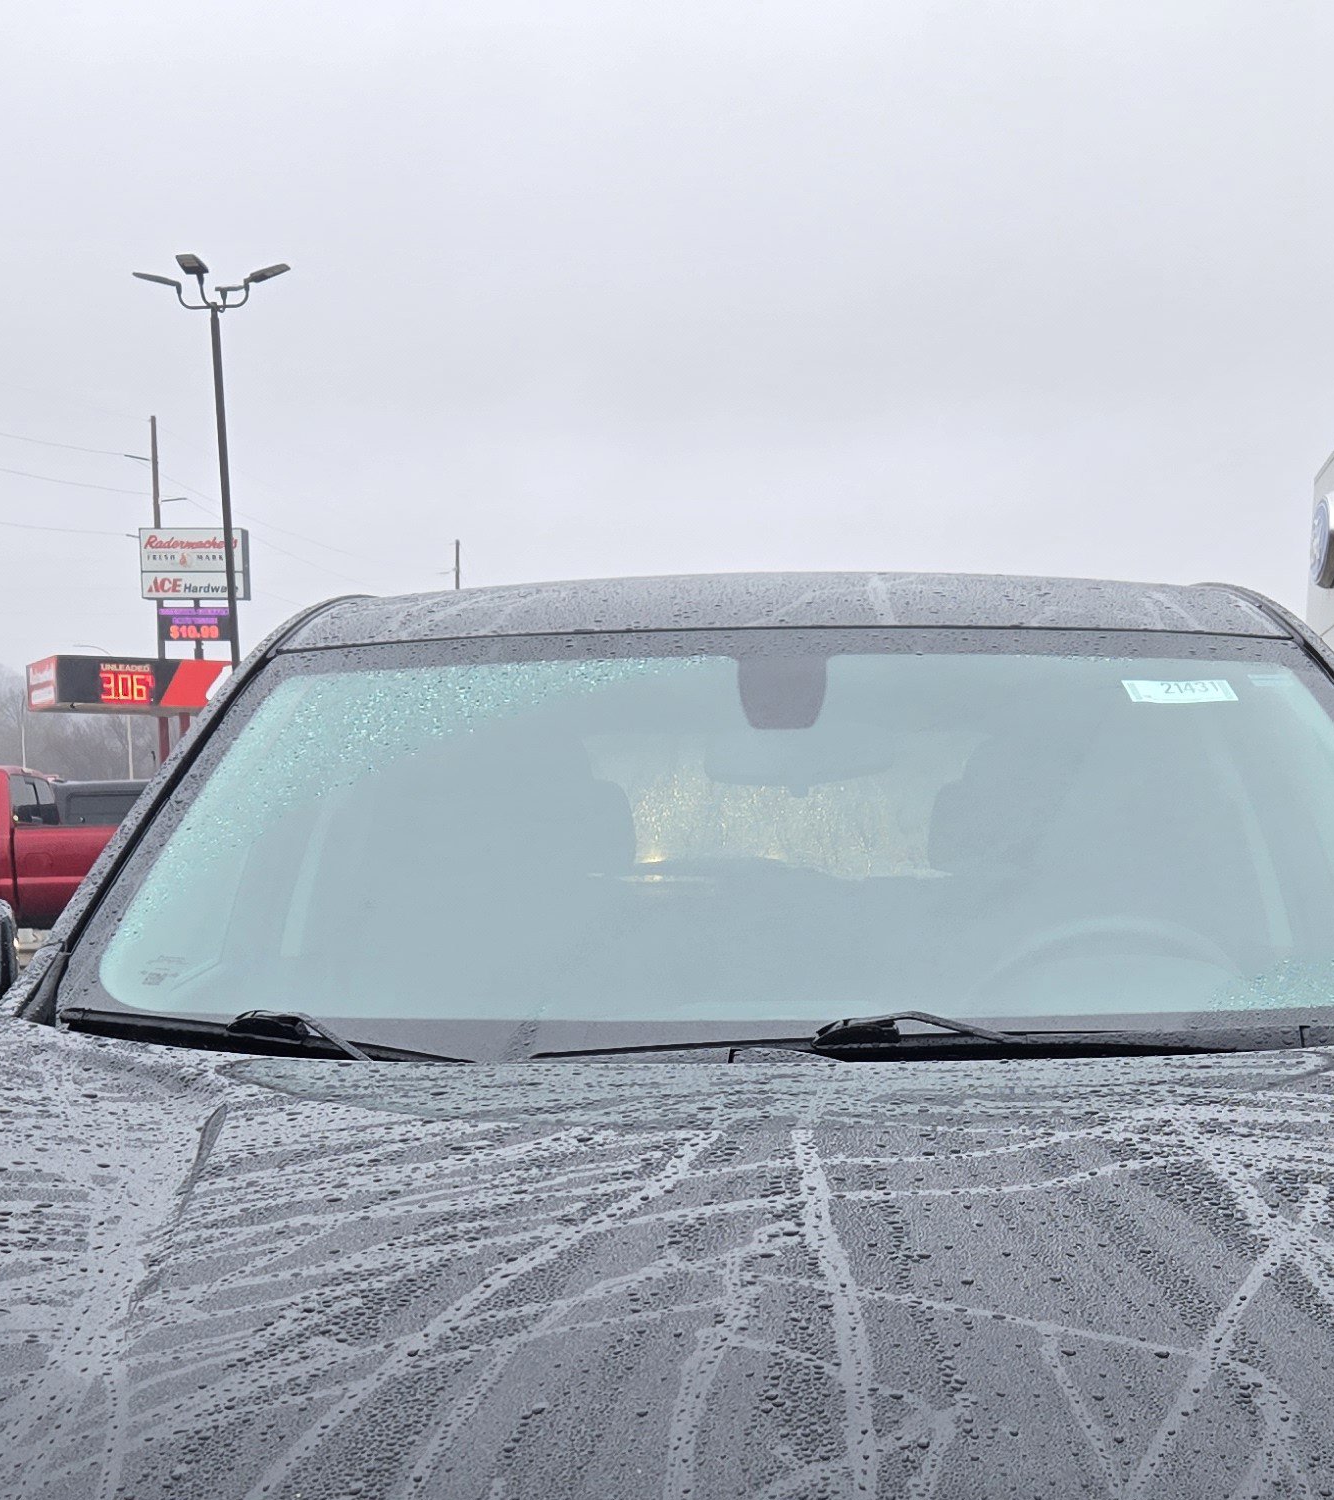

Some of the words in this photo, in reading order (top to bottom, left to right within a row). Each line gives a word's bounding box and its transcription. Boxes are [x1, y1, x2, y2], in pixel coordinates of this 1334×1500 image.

[148, 576, 183, 593] ACE
[183, 582, 238, 594] Hardwae
[99, 663, 151, 672] UNLEADED
[1160, 680, 1219, 695] 21431
